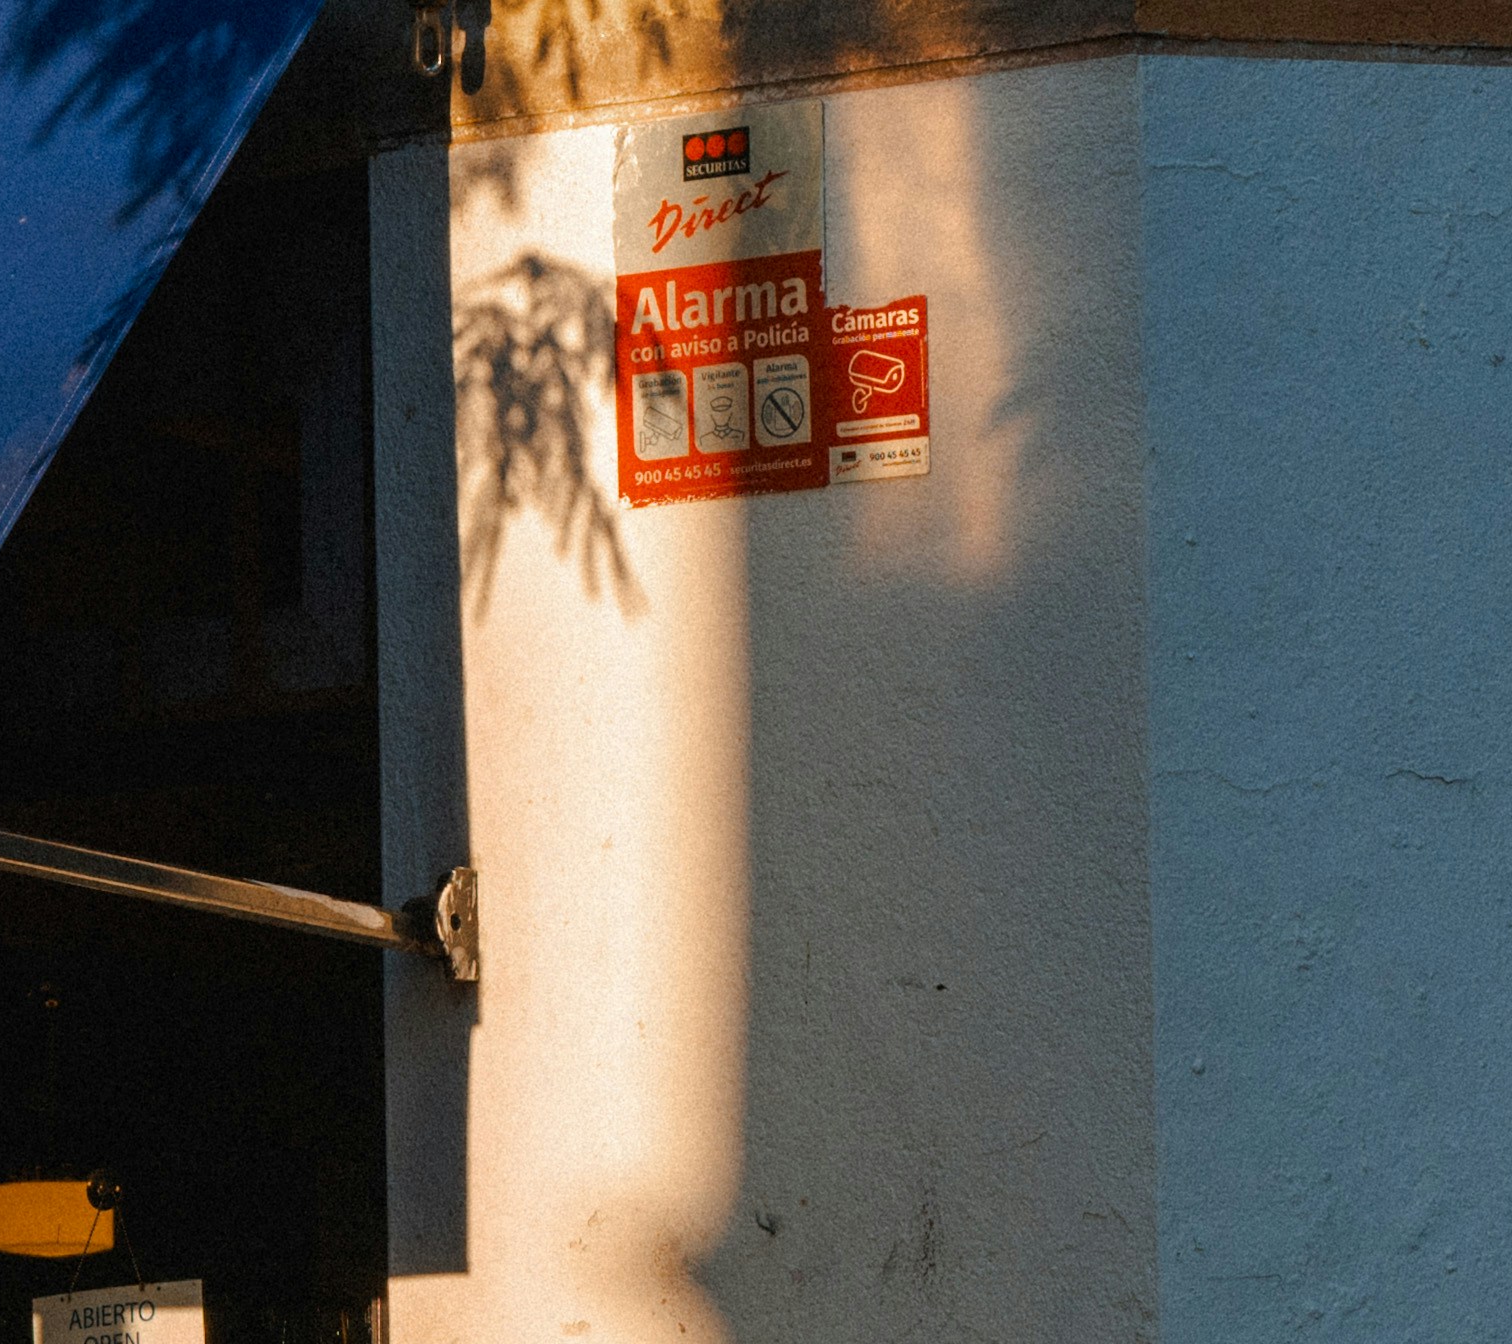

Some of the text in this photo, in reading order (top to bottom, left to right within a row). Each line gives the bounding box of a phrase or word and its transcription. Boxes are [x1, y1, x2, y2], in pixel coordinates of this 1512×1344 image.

[686, 159, 747, 177] SECURITAS
[647, 169, 790, 254] Direct
[631, 277, 809, 335] Alarma
[831, 307, 920, 334] Cámaras
[630, 321, 810, 363] con aviso a Policía
[832, 332, 871, 345] Grabación
[701, 368, 741, 382] Vigilante
[765, 362, 798, 374] Alarma
[869, 448, 921, 461] 900 45 45 45
[635, 463, 721, 485] 900 45 45 45
[729, 457, 813, 475] securitasdirect.es
[69, 1299, 156, 1332] ABIERTO
